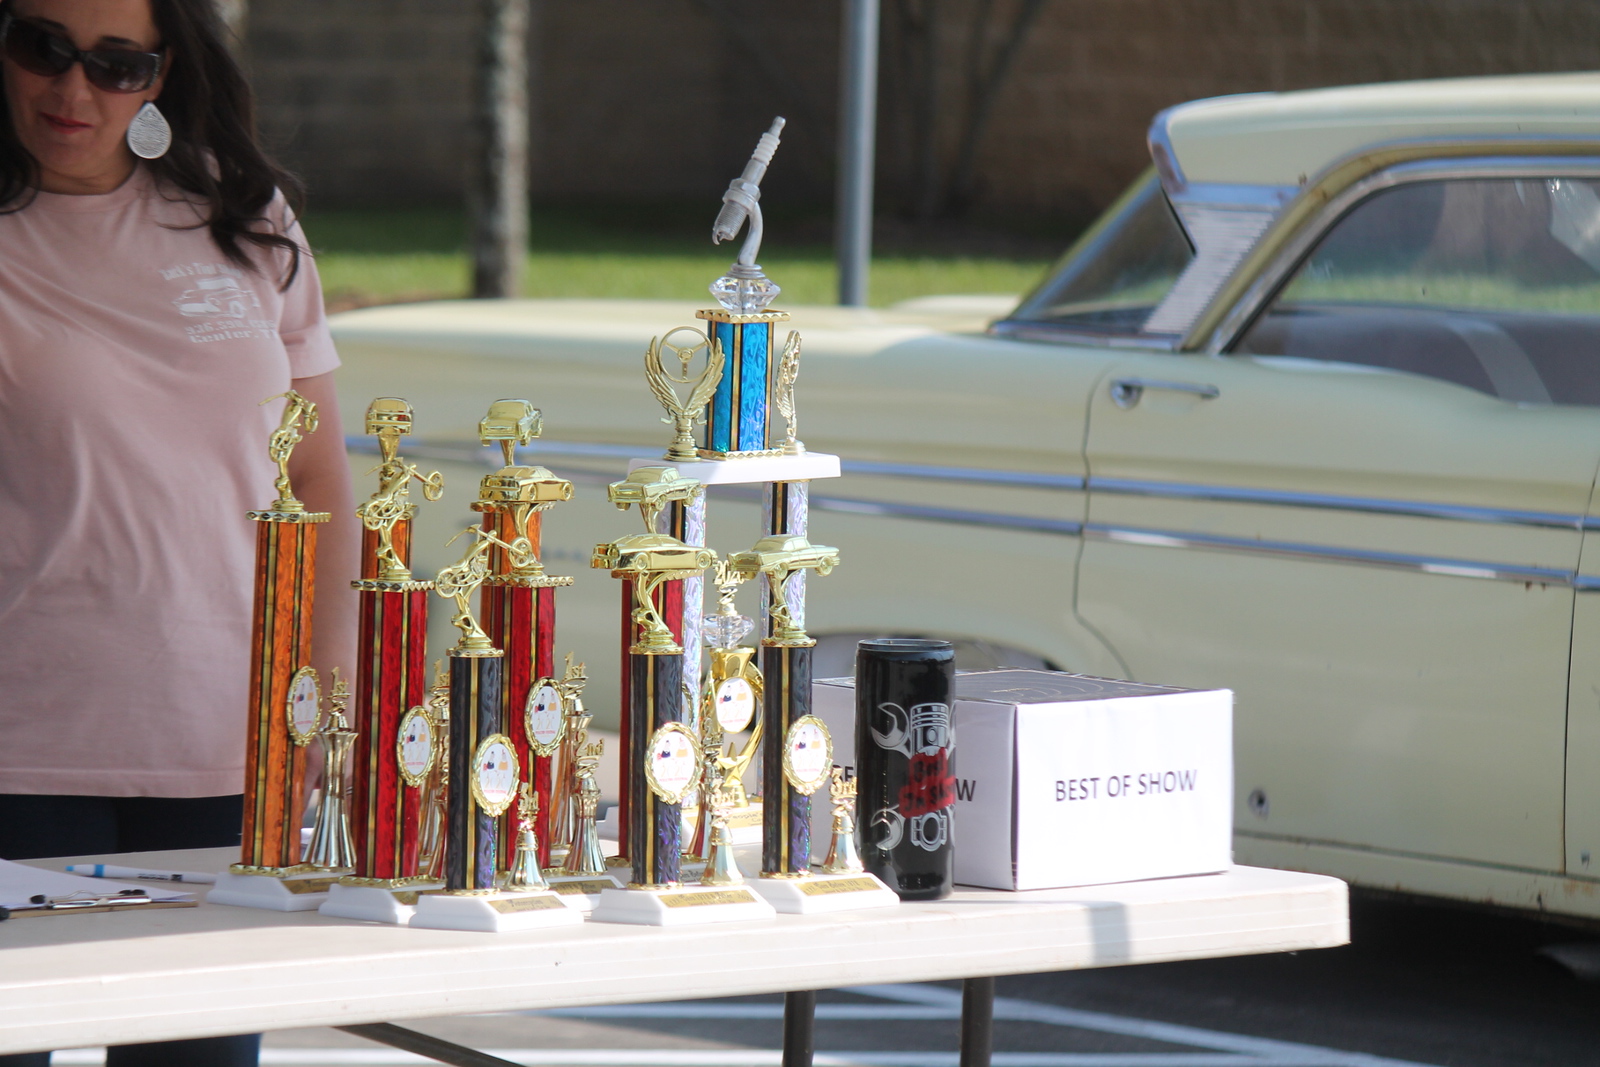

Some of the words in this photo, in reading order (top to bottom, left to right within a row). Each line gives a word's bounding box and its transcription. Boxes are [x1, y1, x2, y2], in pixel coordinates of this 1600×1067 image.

[1055, 777, 1101, 802] BEST
[1107, 775, 1131, 797] OF
[1138, 769, 1198, 795] SHOW
